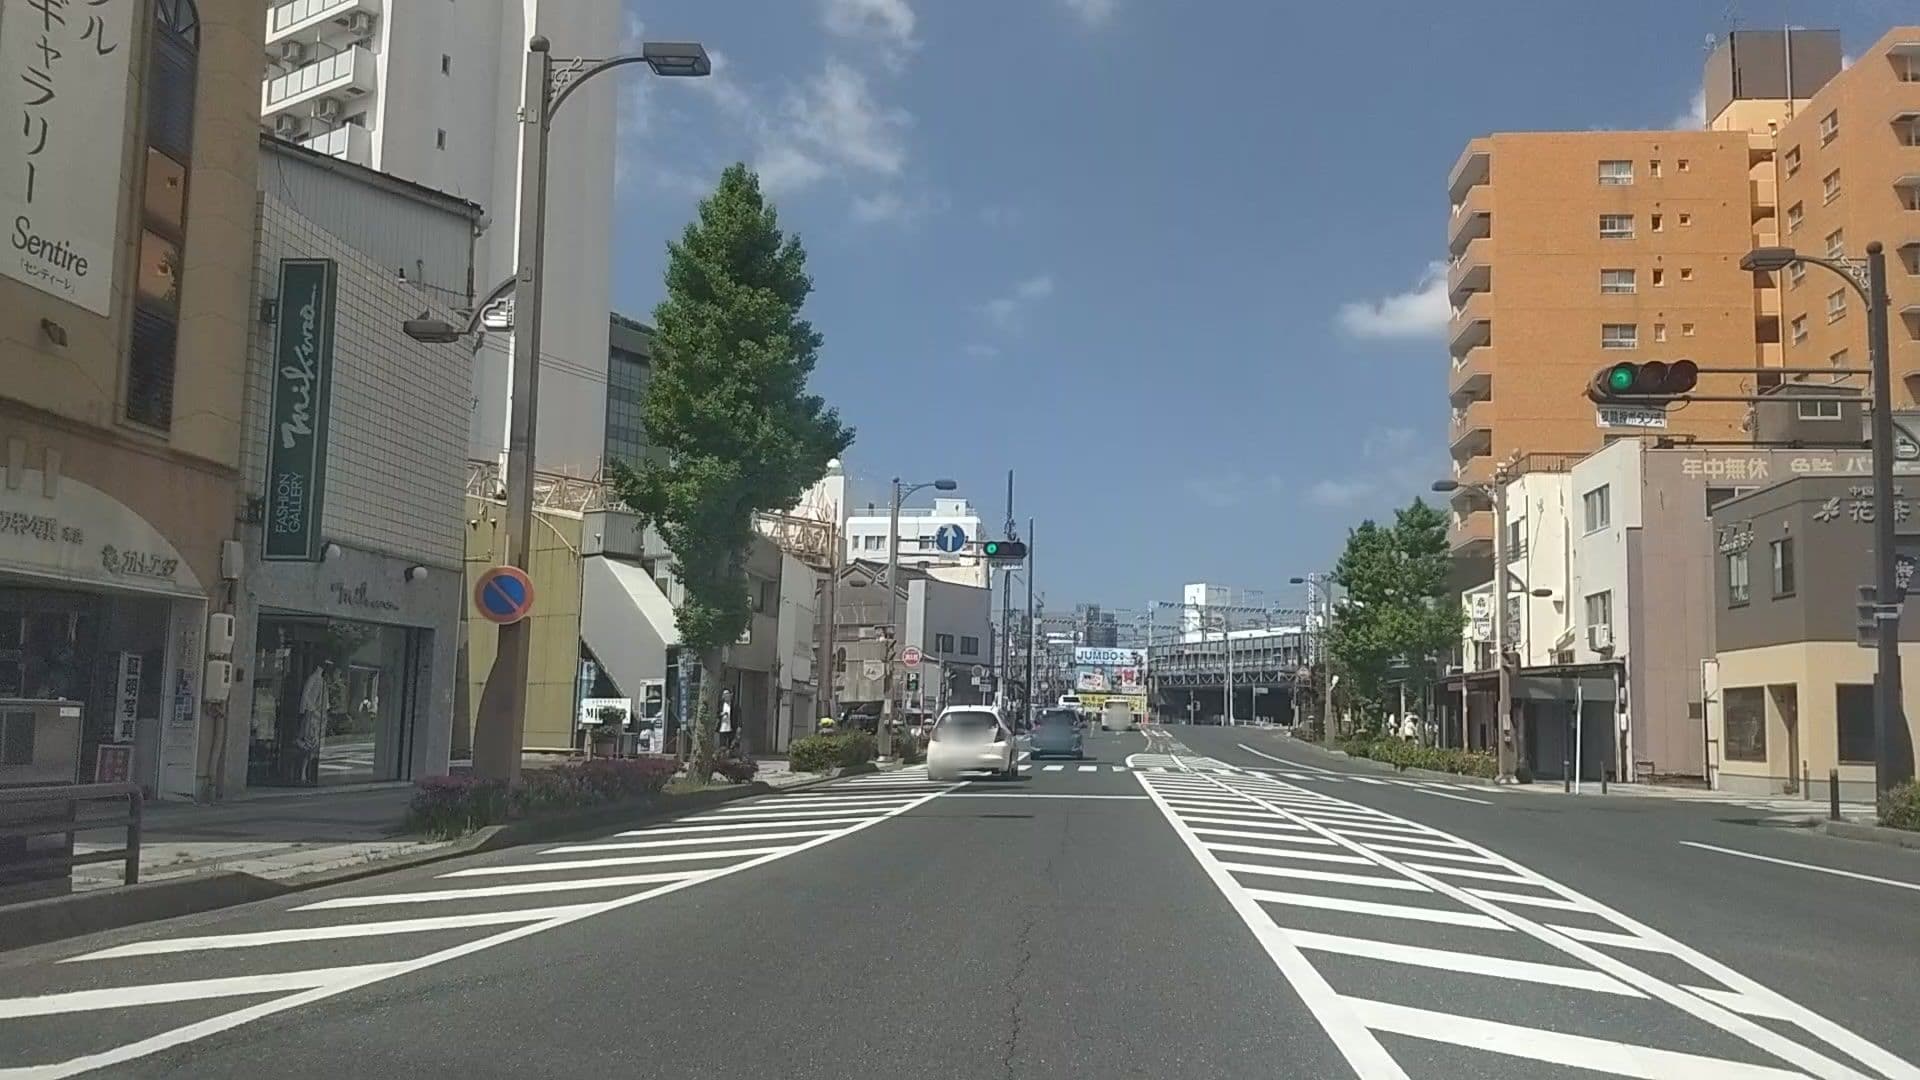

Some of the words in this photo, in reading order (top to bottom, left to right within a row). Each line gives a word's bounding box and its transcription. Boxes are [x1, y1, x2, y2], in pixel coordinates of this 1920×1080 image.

[11, 216, 88, 276] Sentire
[1681, 458, 1769, 480] 年中無休
[275, 472, 290, 533] FASHION
[288, 471, 304, 533] GALLERY
